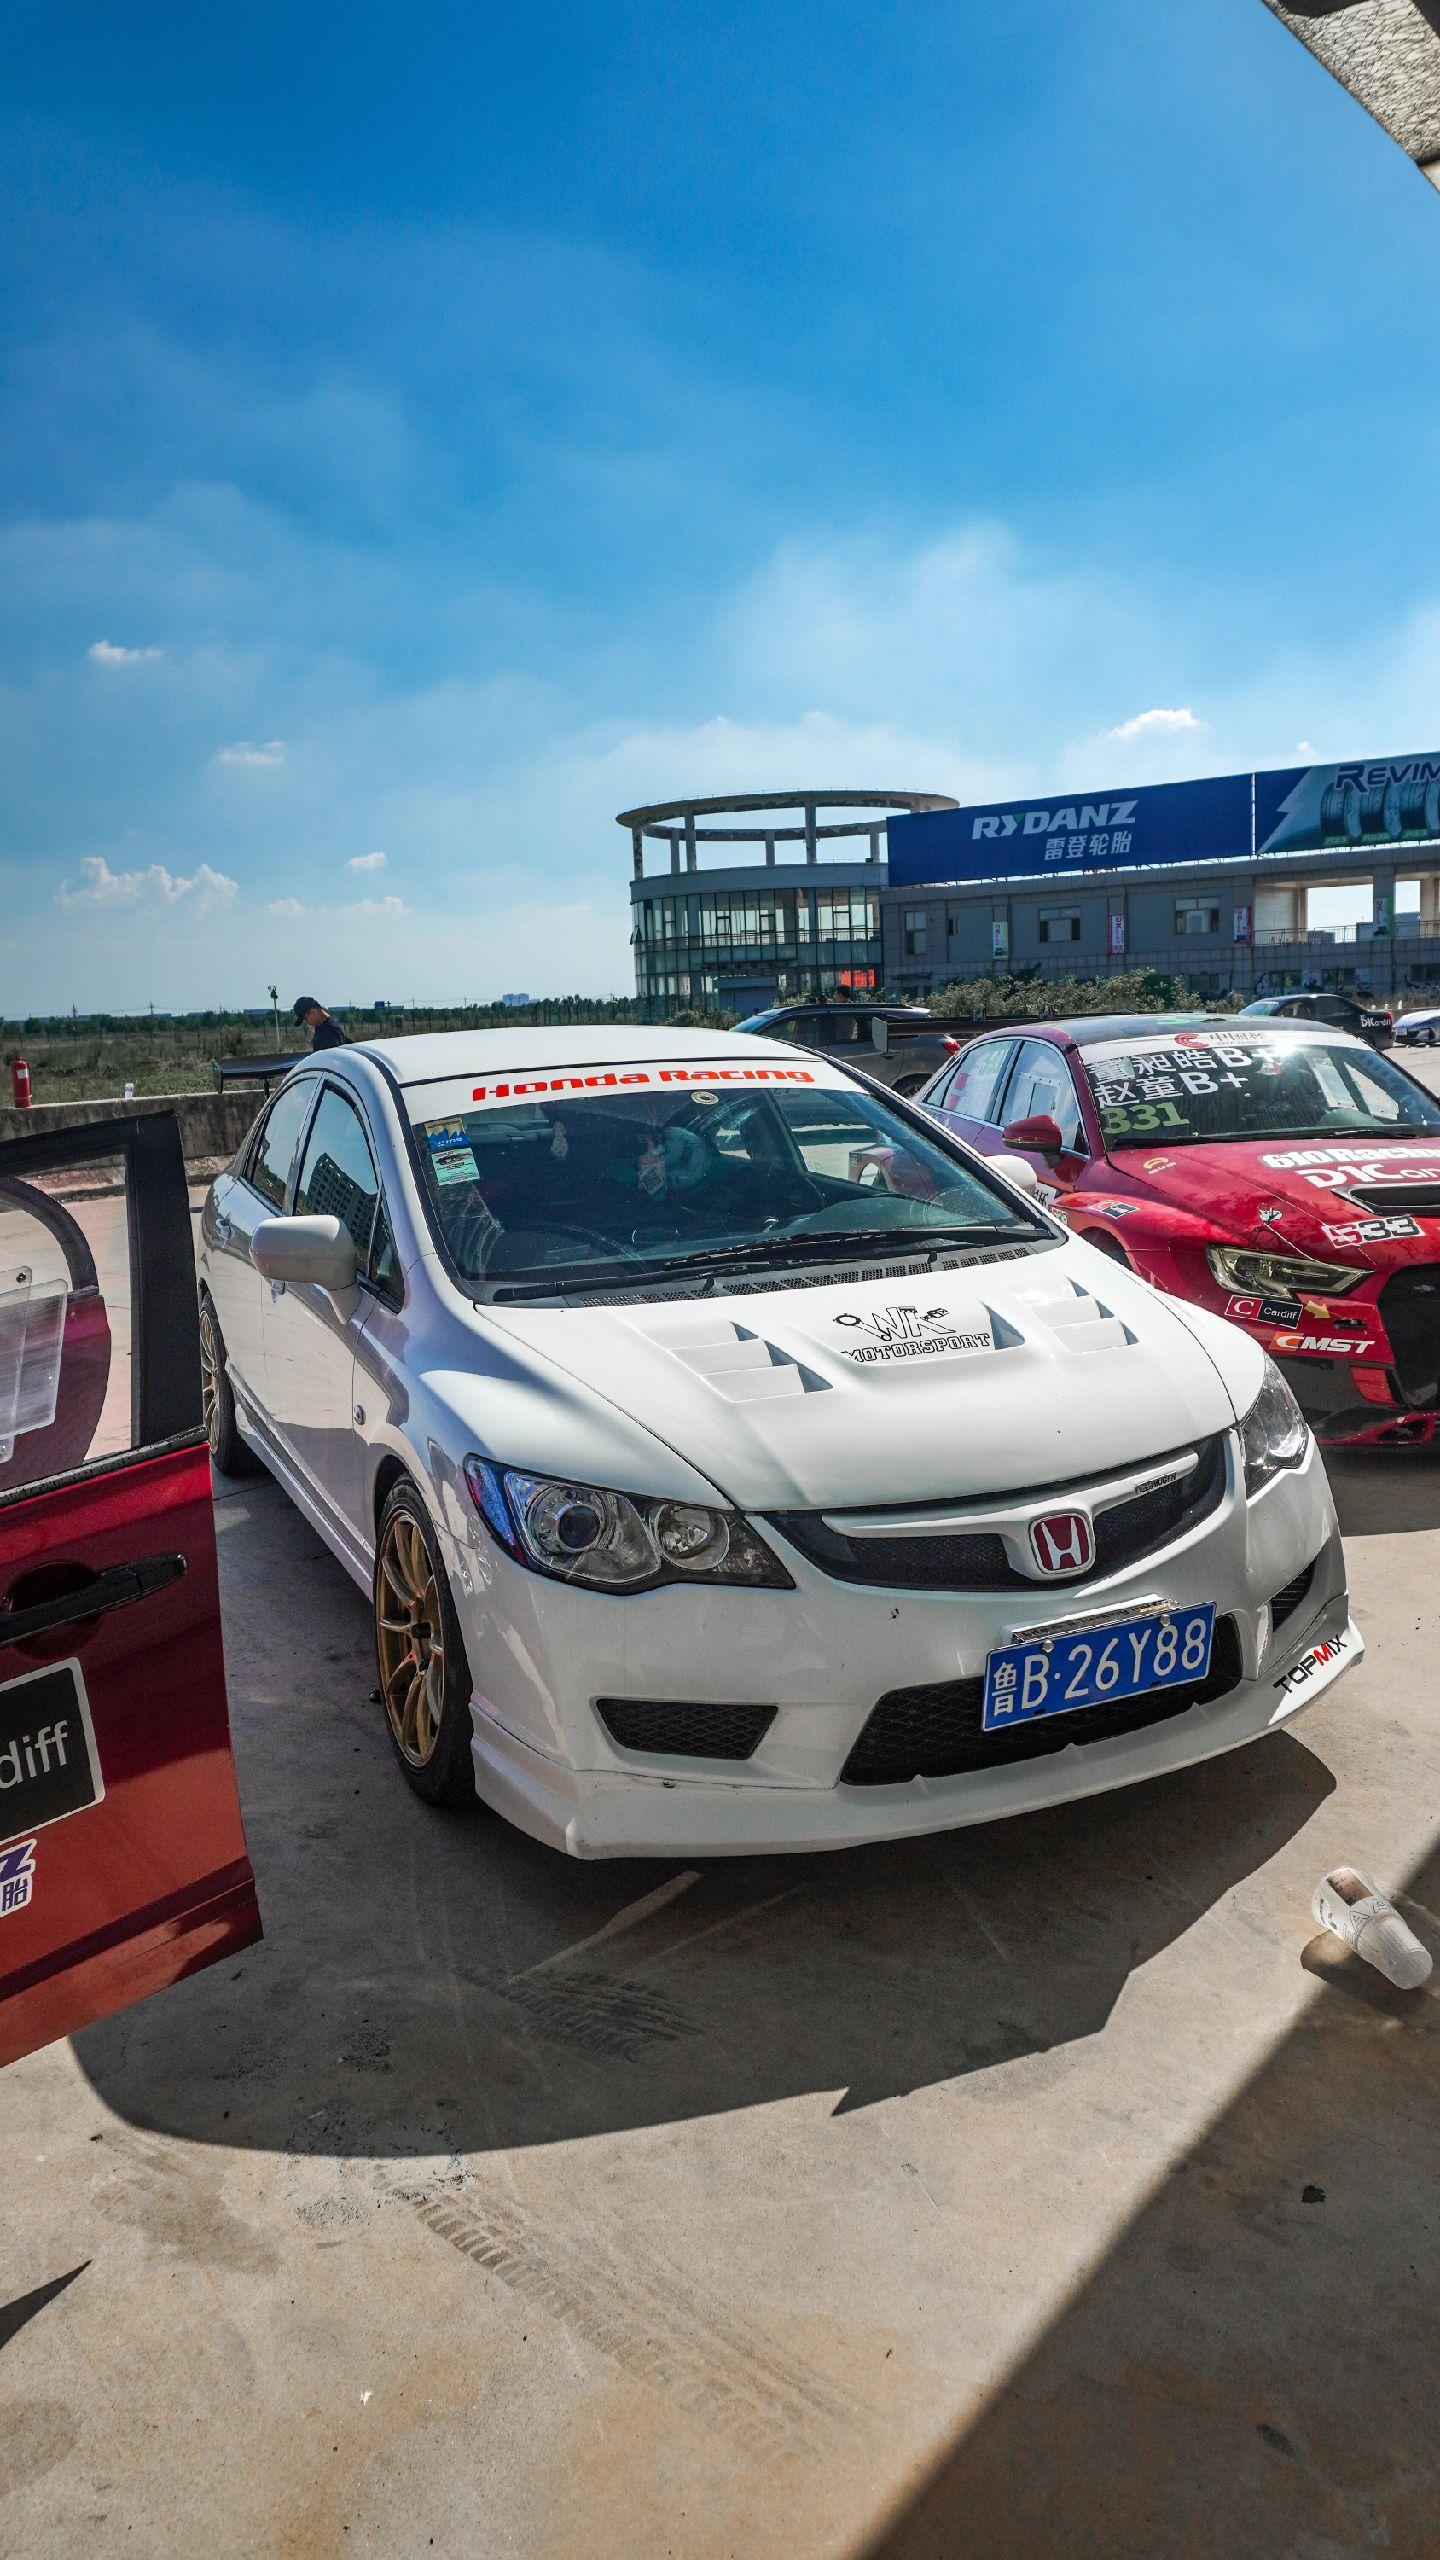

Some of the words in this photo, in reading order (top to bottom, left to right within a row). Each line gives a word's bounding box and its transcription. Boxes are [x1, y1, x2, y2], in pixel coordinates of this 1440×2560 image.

[972, 800, 1138, 840] RYDANZ
[1044, 830, 1133, 861] 雷登轮胎
[472, 1073, 650, 1101] Honda
[658, 1069, 816, 1083] Racing
[1100, 1102, 1190, 1134] 331
[1263, 1307, 1298, 1319] Cardiff
[841, 1332, 990, 1362] MOTORSPORT
[1276, 1334, 1376, 1354] CMST
[1272, 1634, 1348, 1694] TOPMIX
